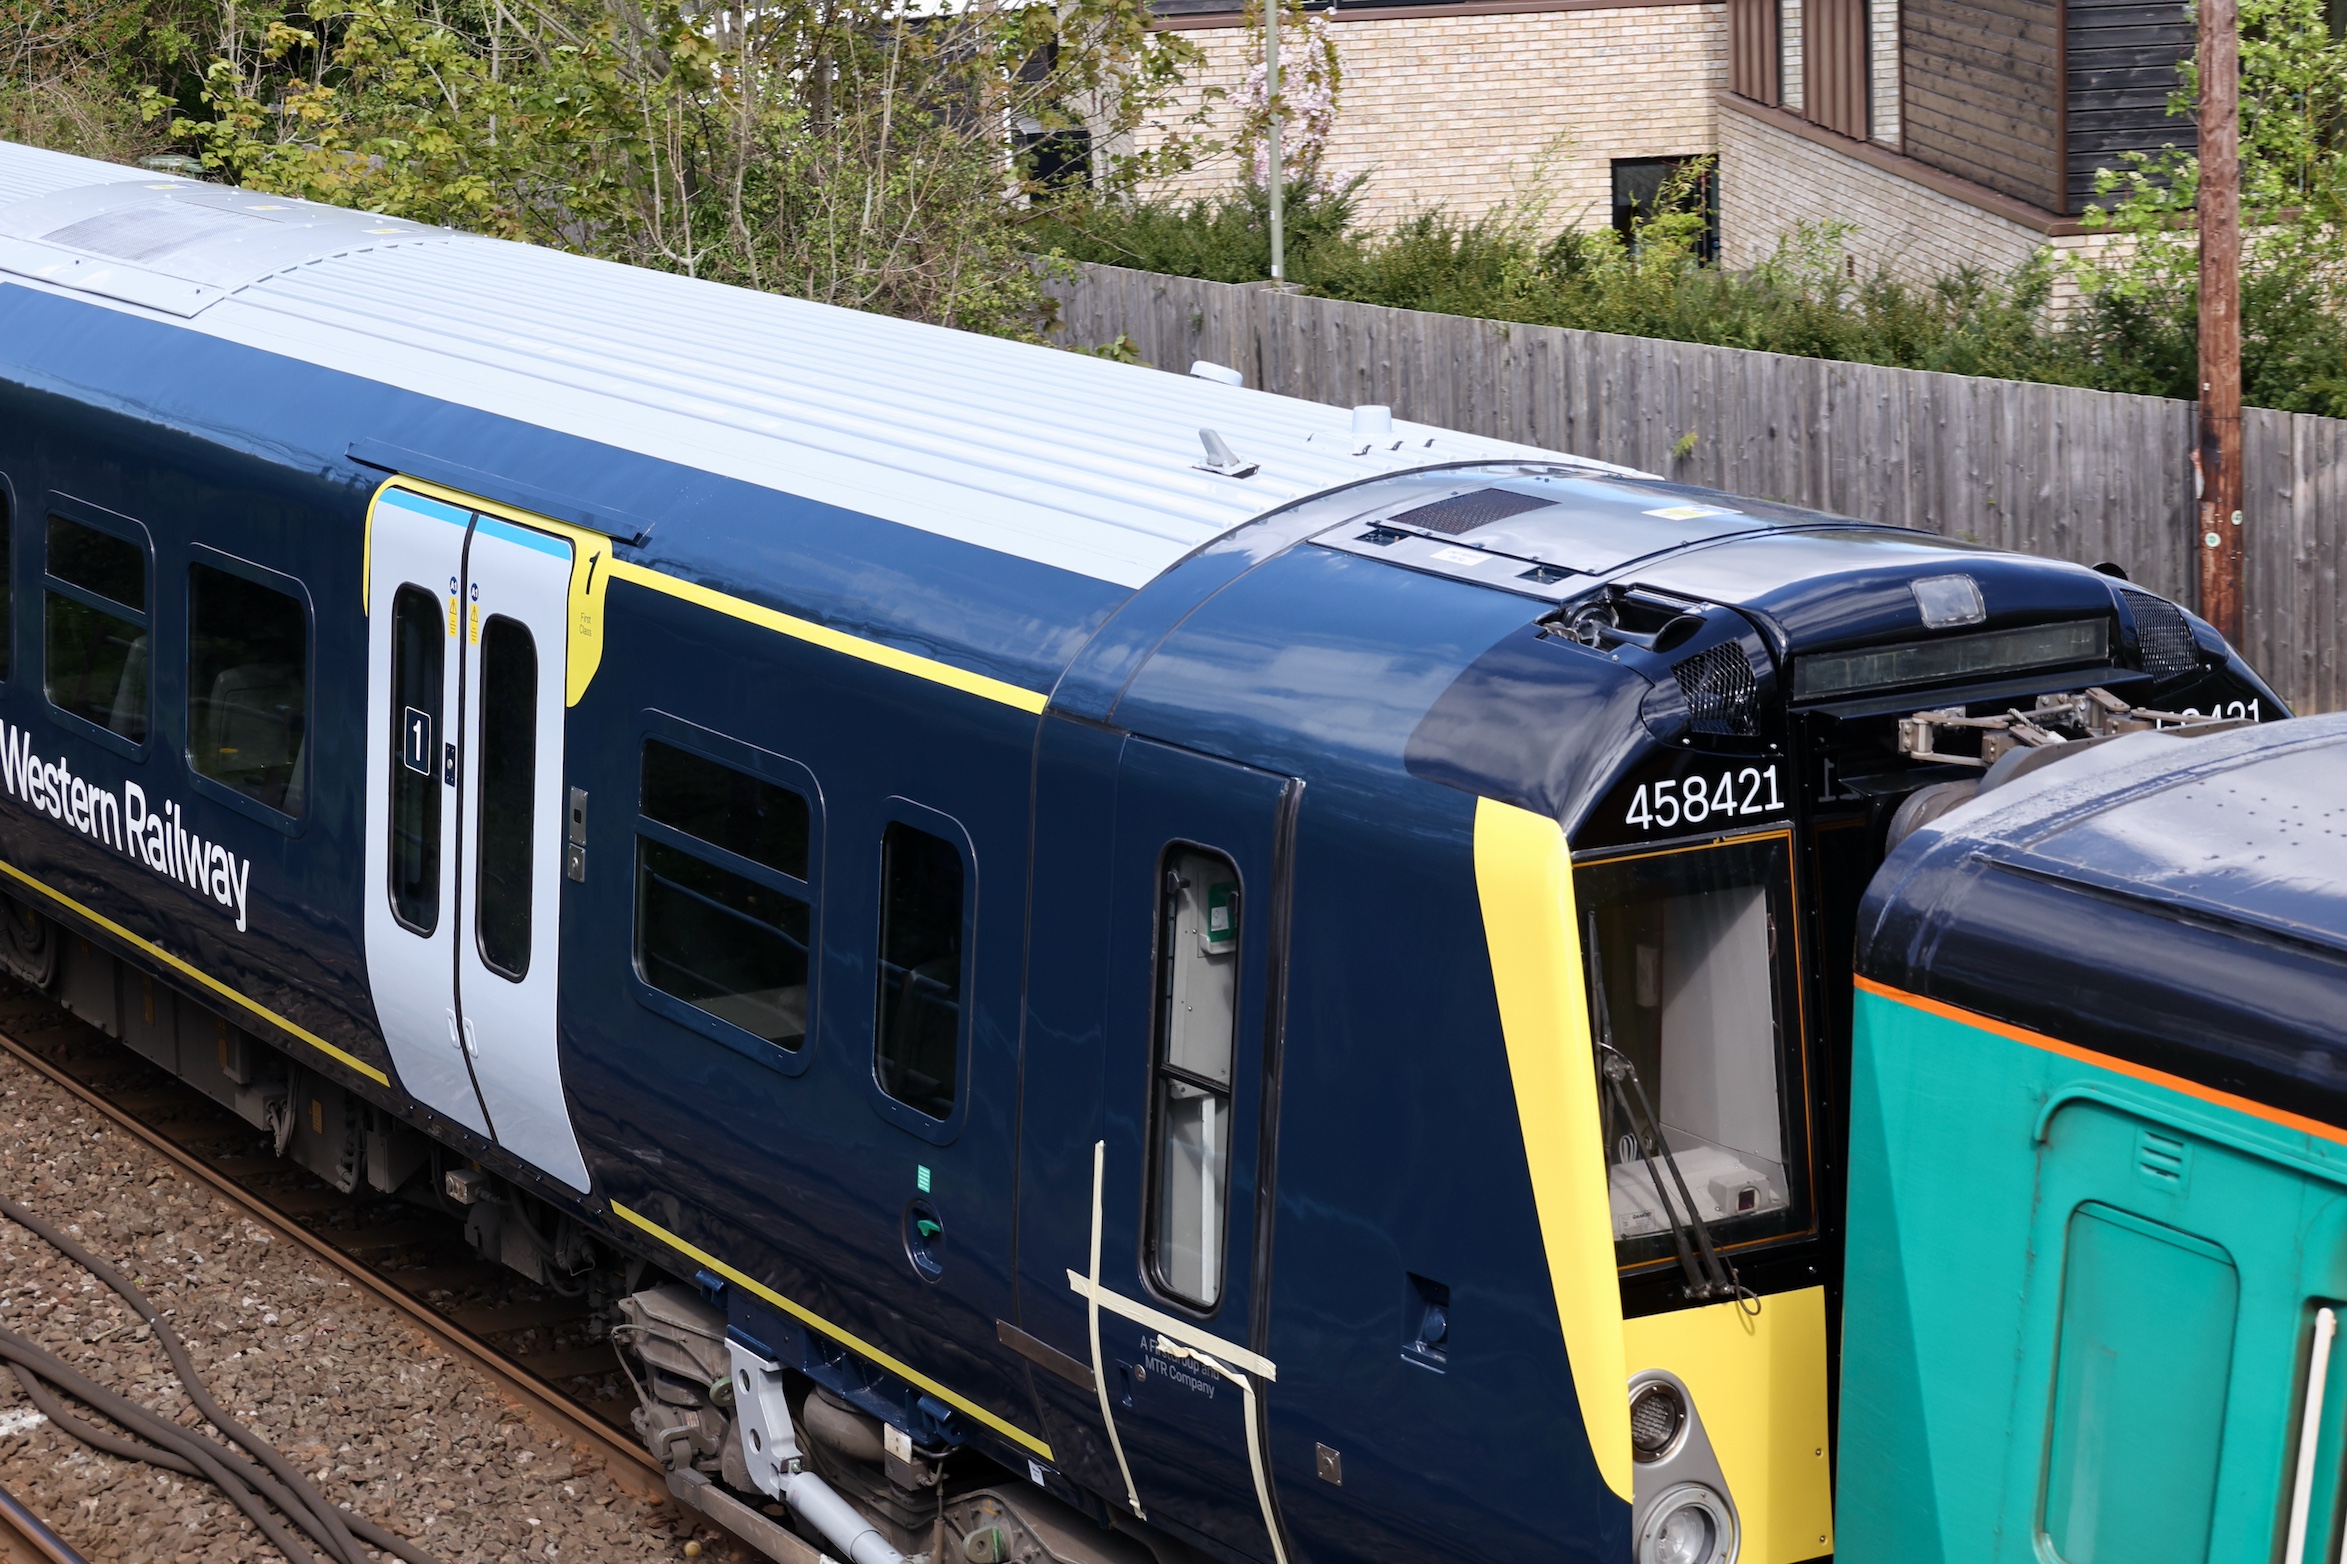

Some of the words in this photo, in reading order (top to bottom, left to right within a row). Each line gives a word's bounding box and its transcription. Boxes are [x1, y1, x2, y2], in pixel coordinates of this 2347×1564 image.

[586, 550, 601, 595] 1
[579, 624, 592, 637] Class
[580, 612, 592, 625] First
[412, 719, 422, 761] 1
[1625, 764, 1785, 830] 458421
[0, 718, 123, 851] Western
[125, 780, 250, 932] Railway
[1140, 1335, 1149, 1351] A
[1149, 1338, 1200, 1374] Fstoup
[1144, 1354, 1168, 1377] MTR
[1169, 1365, 1215, 1399] Company
